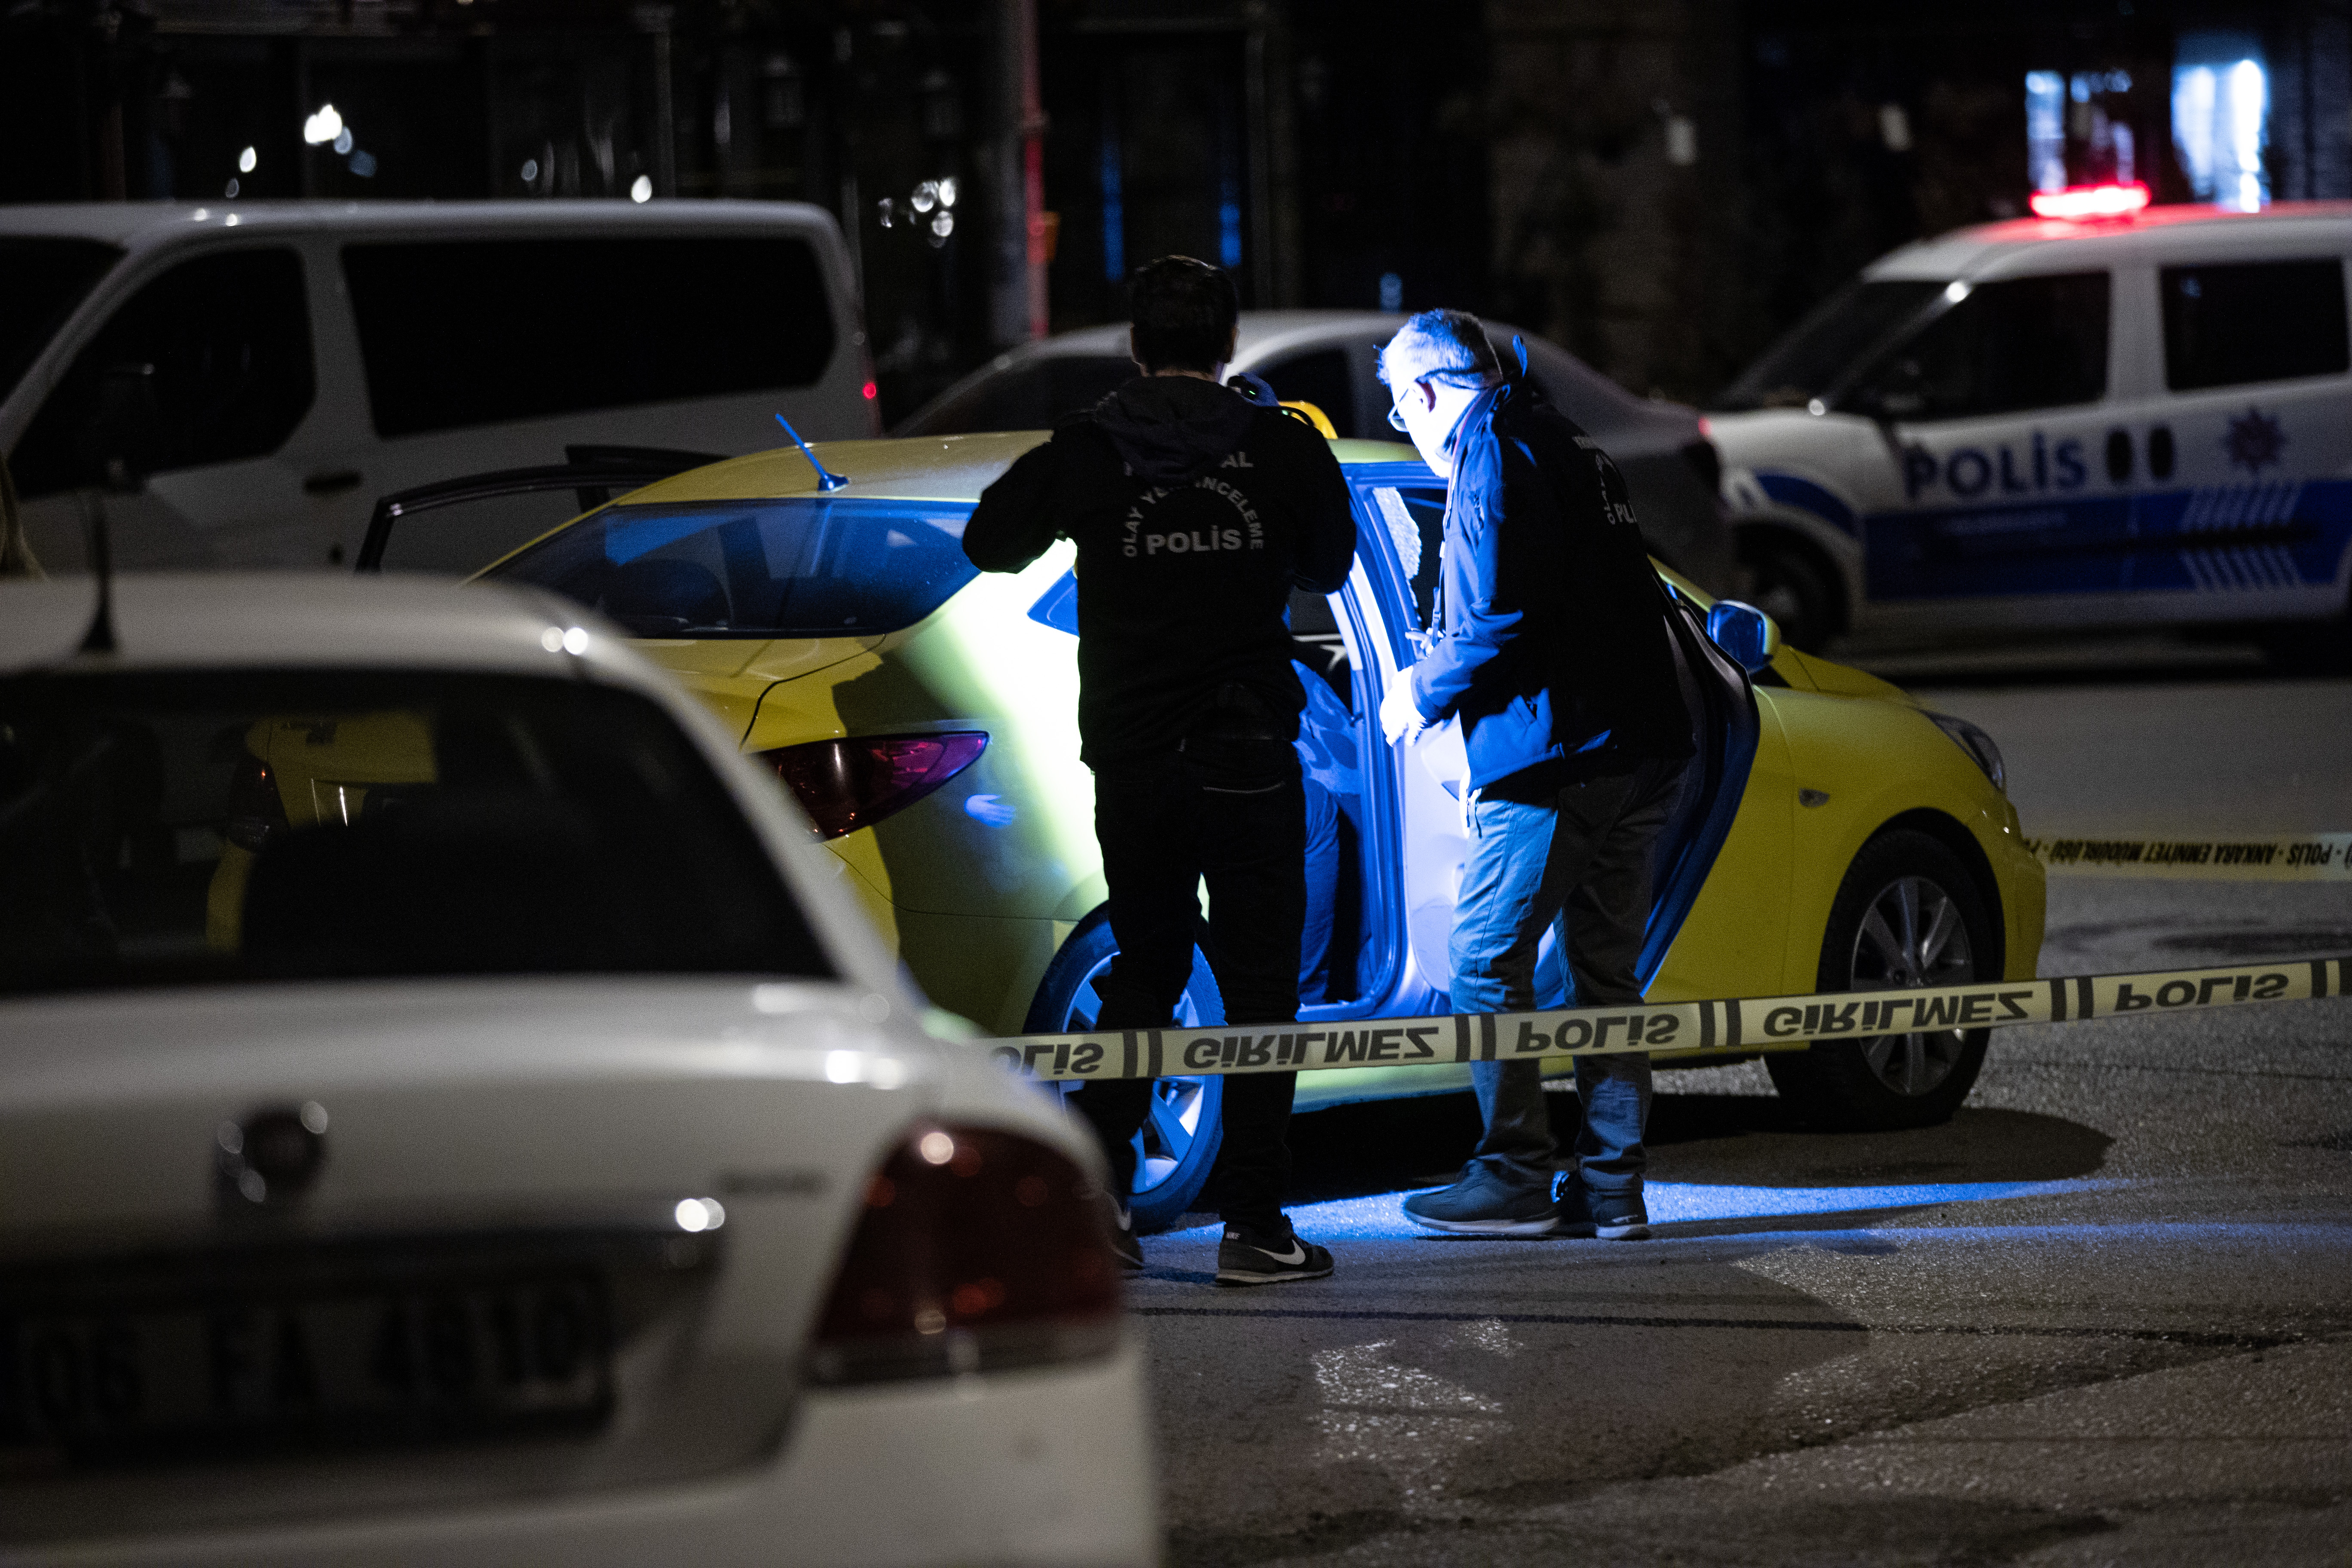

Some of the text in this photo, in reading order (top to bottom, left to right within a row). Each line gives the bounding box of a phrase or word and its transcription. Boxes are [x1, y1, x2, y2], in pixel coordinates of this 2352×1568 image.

[1903, 432, 2087, 501] POLİS
[1122, 506, 1144, 558] OLAY
[1145, 525, 1242, 555] POLİS
[32, 1322, 143, 1420] 06
[206, 1305, 319, 1409] FA
